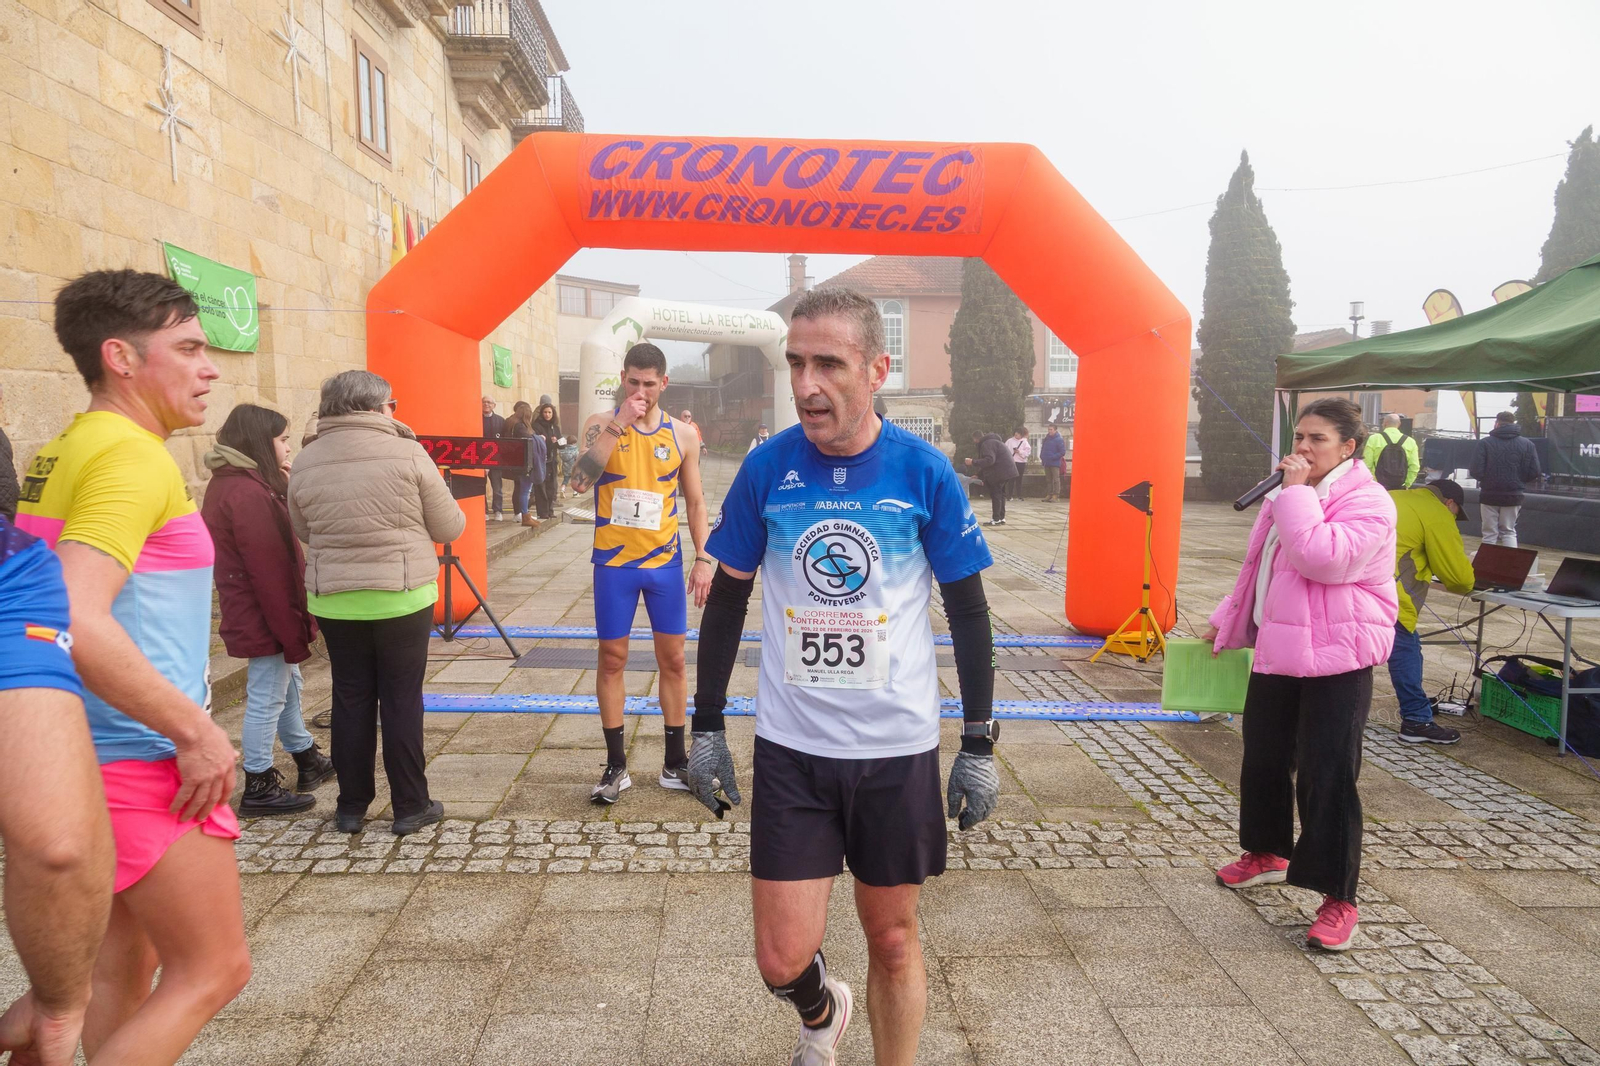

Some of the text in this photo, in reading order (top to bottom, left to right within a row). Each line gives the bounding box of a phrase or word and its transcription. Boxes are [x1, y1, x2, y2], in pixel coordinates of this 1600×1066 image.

[588, 140, 975, 196] CRONOTEC
[588, 189, 967, 232] WWW.CRONOTEC.ES
[652, 307, 693, 324] HOTEL
[700, 312, 715, 326] LA
[651, 324, 723, 336] www.hotelrectoral.com
[595, 387, 616, 396] rode
[633, 501, 640, 518] 1
[794, 524, 829, 561] SOCIEDAD
[807, 590, 867, 607] PONTEVEDRA
[791, 617, 880, 627] CONTRA O CANCRO
[803, 610, 864, 619] CORREMOS
[801, 632, 865, 668] 553
